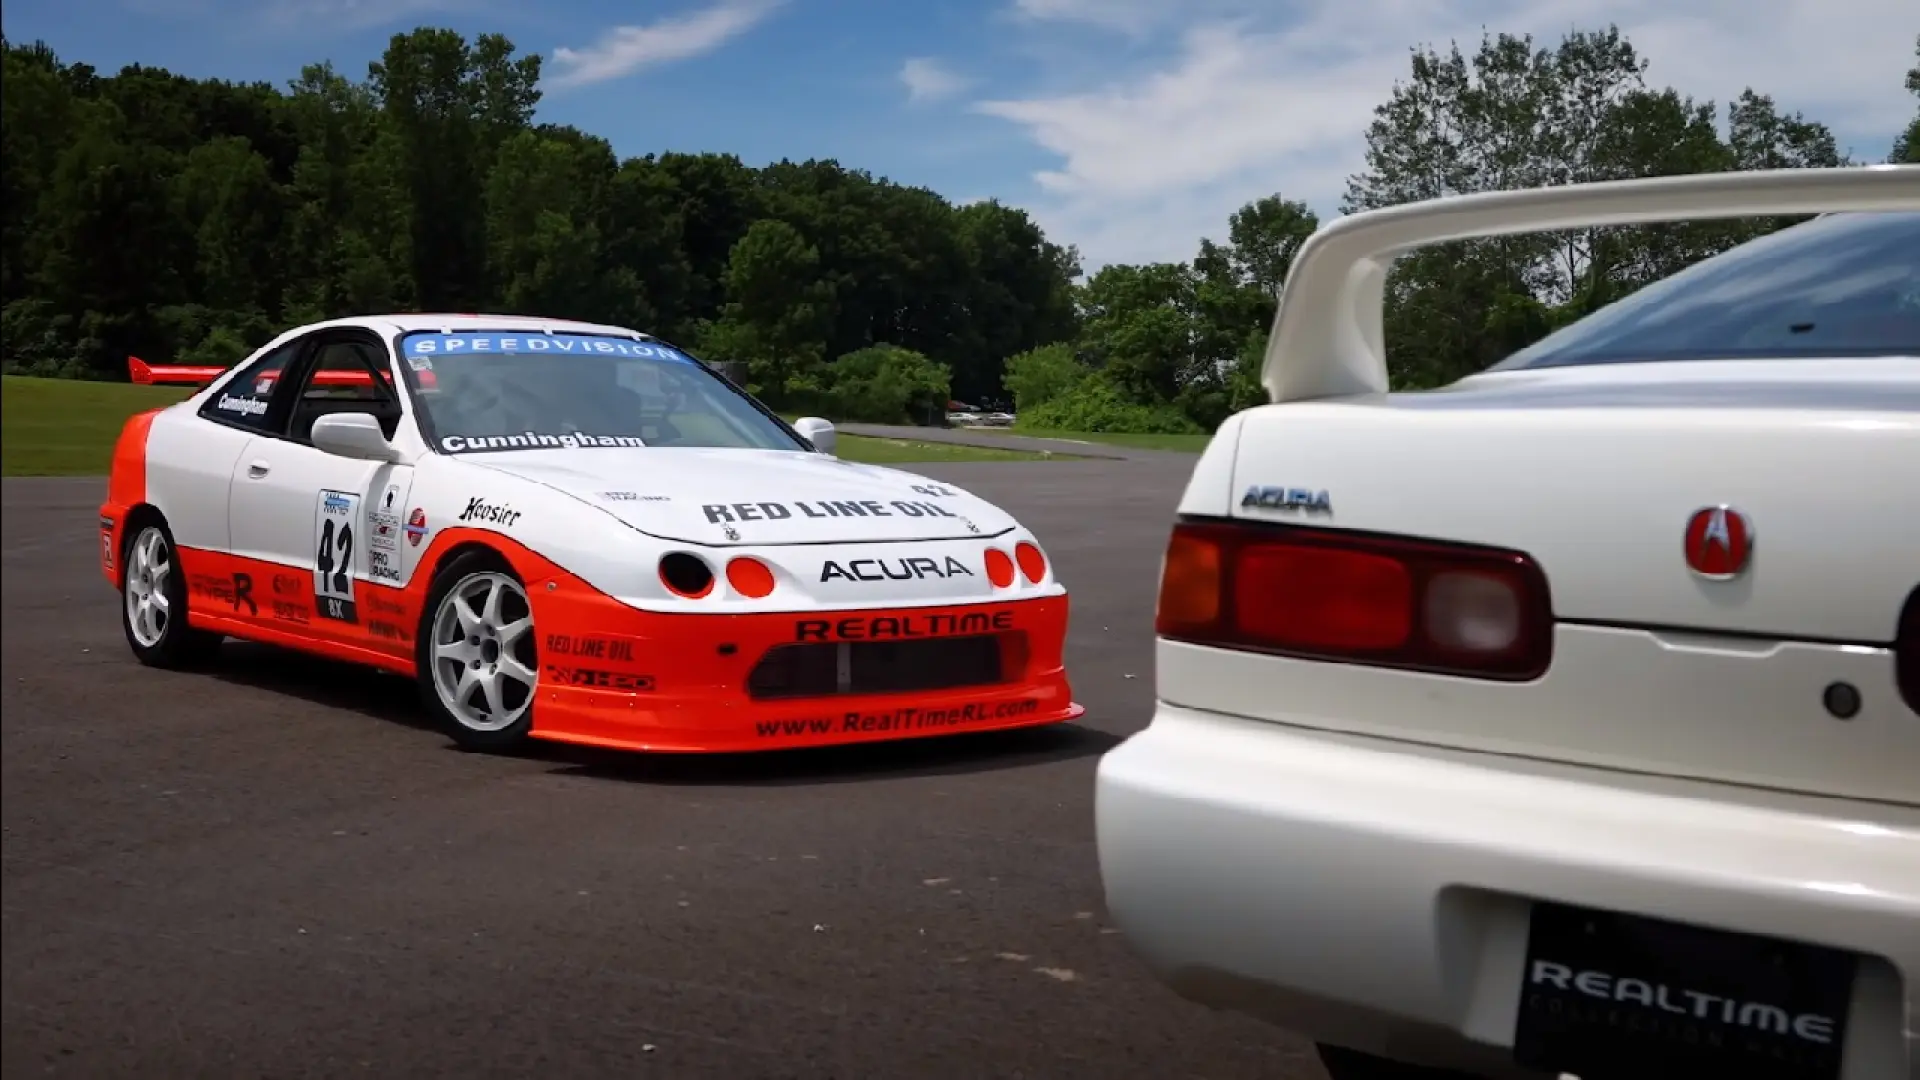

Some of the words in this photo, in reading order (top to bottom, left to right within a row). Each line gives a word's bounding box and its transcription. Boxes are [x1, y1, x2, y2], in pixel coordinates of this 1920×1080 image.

[414, 338, 681, 361] SPEEDVISION
[441, 431, 646, 451] Cunningham
[911, 484, 956, 497] 42
[1241, 485, 1333, 515] ACURA
[459, 496, 522, 527] Hoosier
[702, 502, 791, 524] RED
[795, 501, 892, 517] LINE
[891, 501, 958, 518] OIL
[317, 518, 352, 595] 42
[820, 556, 974, 583] ACURA
[795, 611, 1014, 641] REALTIME
[547, 633, 571, 654] RED
[572, 637, 605, 658] LINE
[608, 640, 635, 661] OIL
[756, 698, 1038, 737] www.RealTimeRL.com
[1531, 959, 1836, 1044] REALTIME
